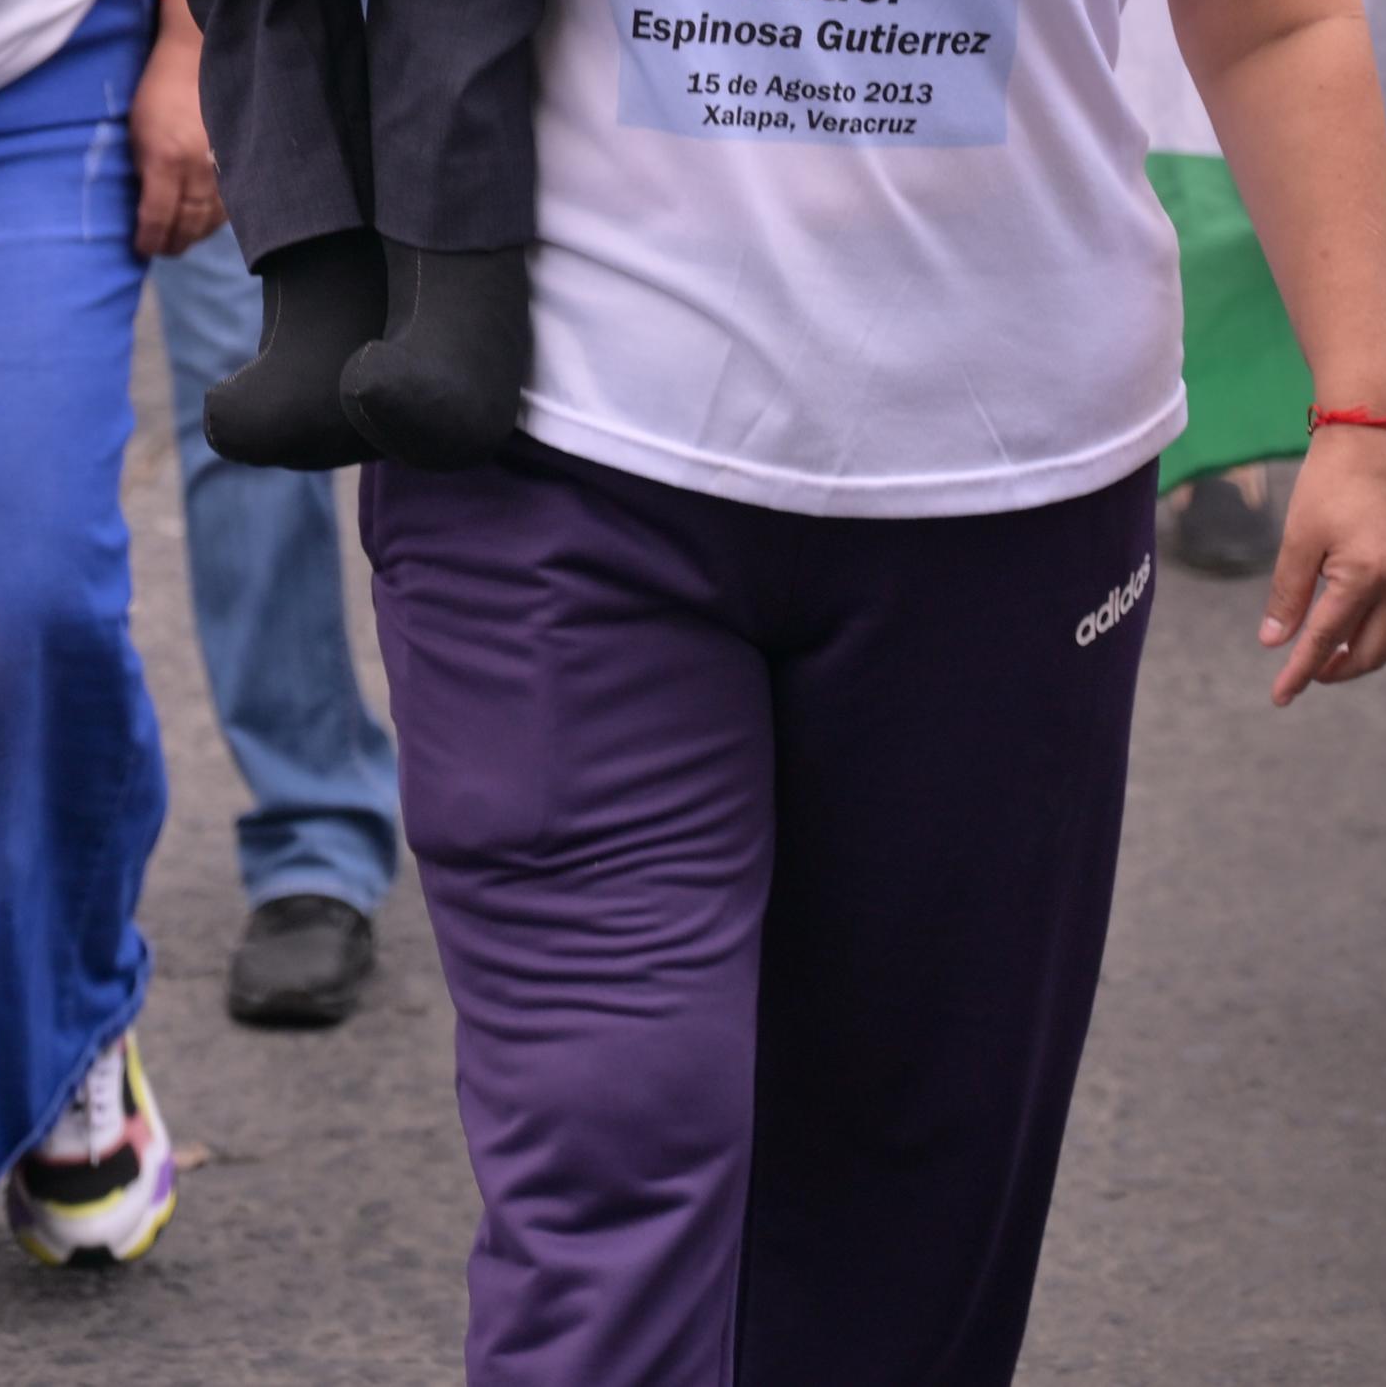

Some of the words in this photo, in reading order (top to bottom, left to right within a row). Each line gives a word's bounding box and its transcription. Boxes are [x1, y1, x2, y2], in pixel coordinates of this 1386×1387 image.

[632, 9, 803, 50] Espinosa
[816, 20, 992, 55] Gutierrez
[686, 73, 721, 95] 15
[727, 74, 758, 96] de
[765, 75, 857, 102] Agosto
[863, 82, 934, 104] 2013
[702, 105, 796, 132] Xalapa,
[807, 109, 918, 134] Veracruz
[1075, 553, 1151, 647] adidas
